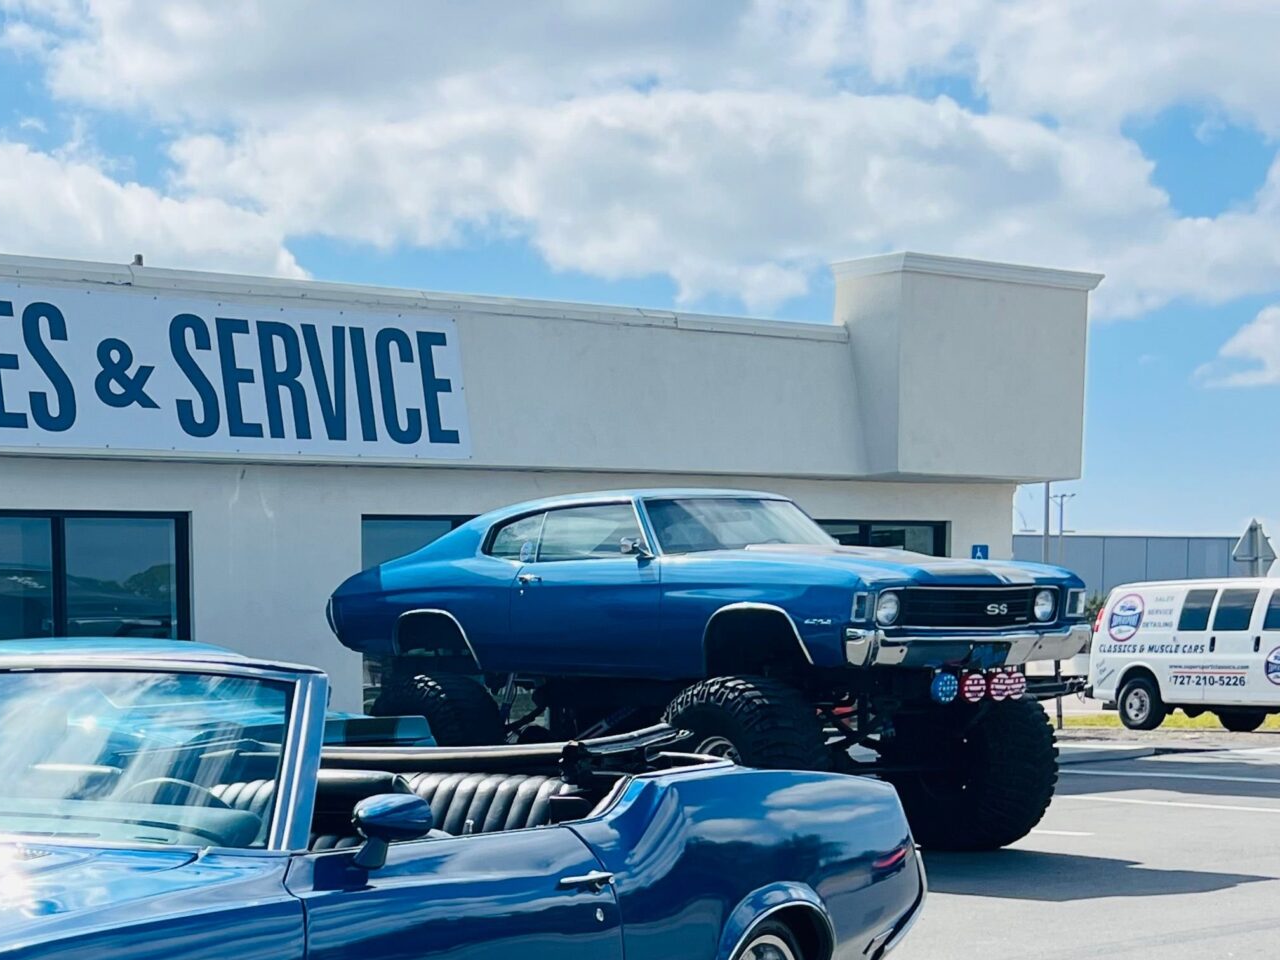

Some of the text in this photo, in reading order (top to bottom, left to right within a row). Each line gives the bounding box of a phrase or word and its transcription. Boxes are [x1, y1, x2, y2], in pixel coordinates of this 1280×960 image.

[94, 337, 162, 409] &
[169, 313, 460, 444] SERVICE
[986, 603, 1008, 615] SS
[1099, 644, 1137, 653] CLASSICS
[1147, 644, 1180, 653] MUSCLE
[1182, 644, 1205, 653] CARS
[1173, 675, 1246, 686] 727-210-5226
